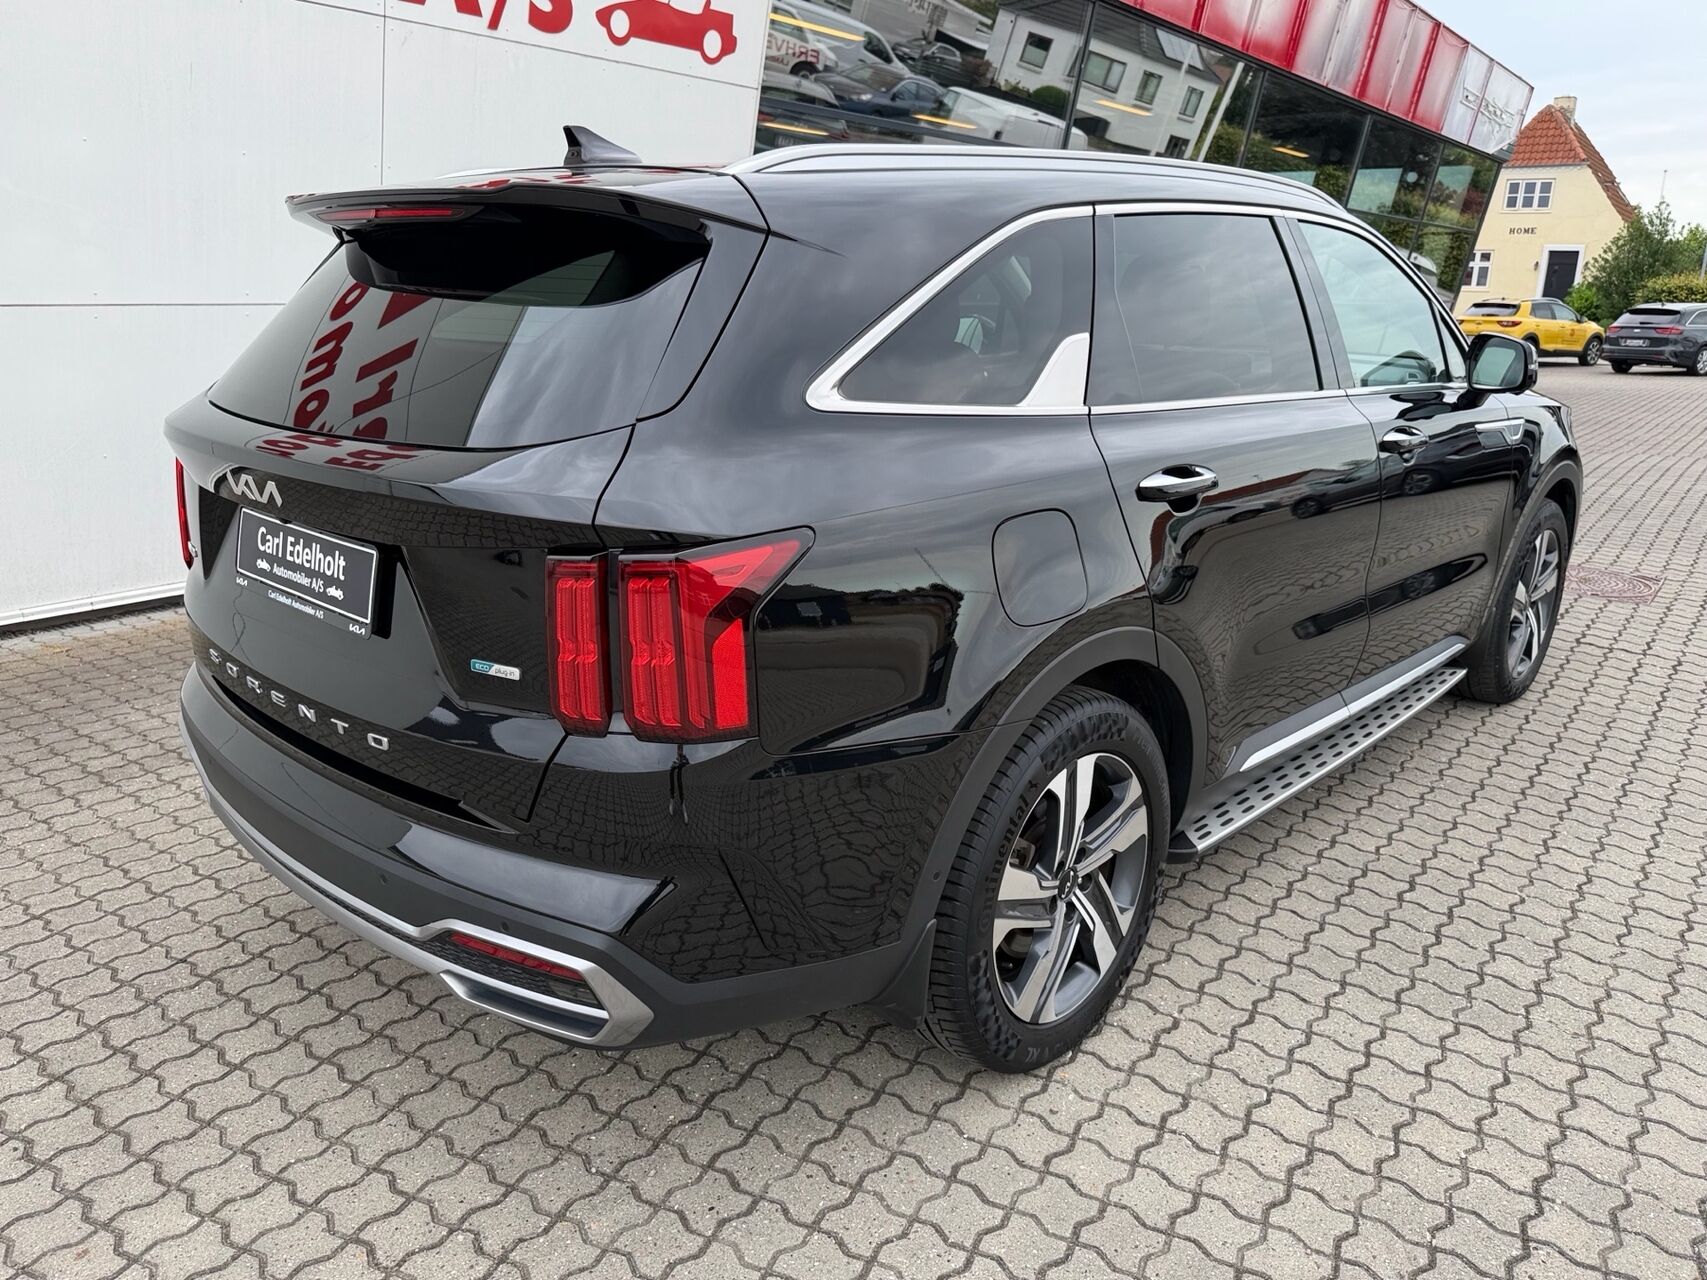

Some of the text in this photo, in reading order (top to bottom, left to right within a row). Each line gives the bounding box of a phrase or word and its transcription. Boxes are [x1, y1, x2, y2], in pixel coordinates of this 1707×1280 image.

[1508, 227, 1537, 235] HOME
[226, 470, 283, 507] KIA
[257, 527, 346, 581] Carl Edelholt
[272, 563, 325, 593] Automobiler A/S
[209, 648, 391, 752] SORENTO
